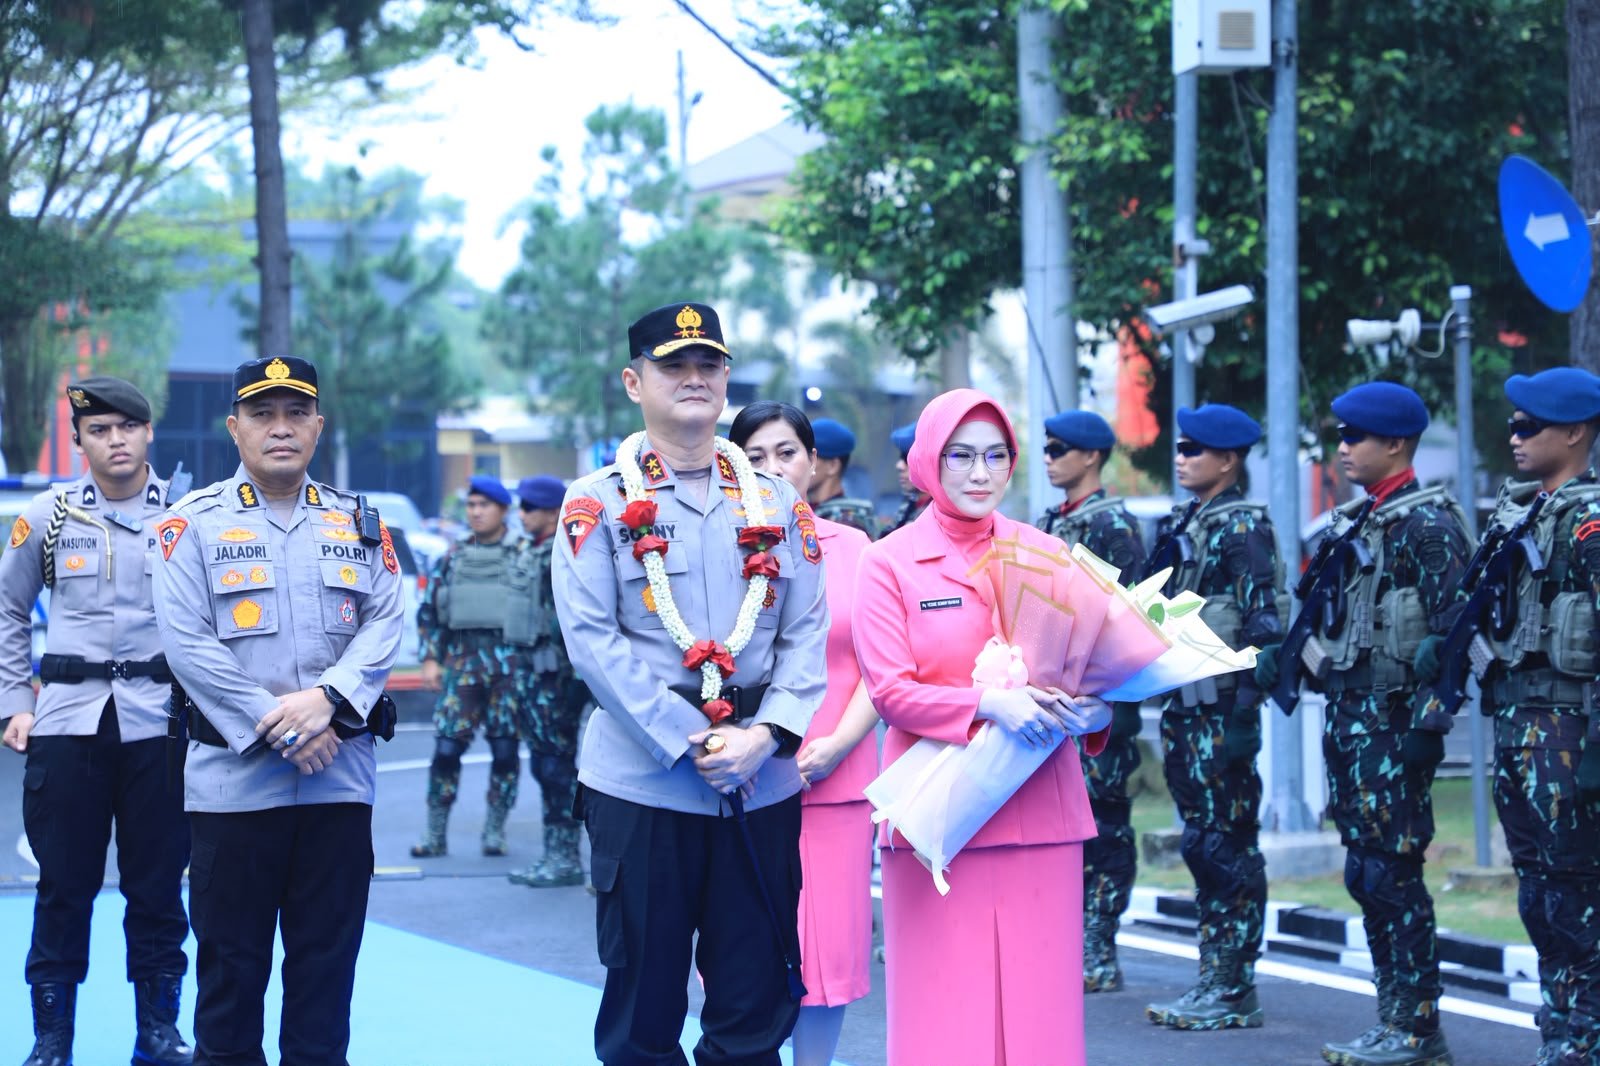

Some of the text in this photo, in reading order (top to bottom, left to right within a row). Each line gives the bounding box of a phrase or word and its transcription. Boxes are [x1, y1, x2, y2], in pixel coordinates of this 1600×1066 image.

[619, 524, 675, 544] SONY
[214, 544, 267, 562] JALADRI
[321, 544, 367, 562] POLRI
